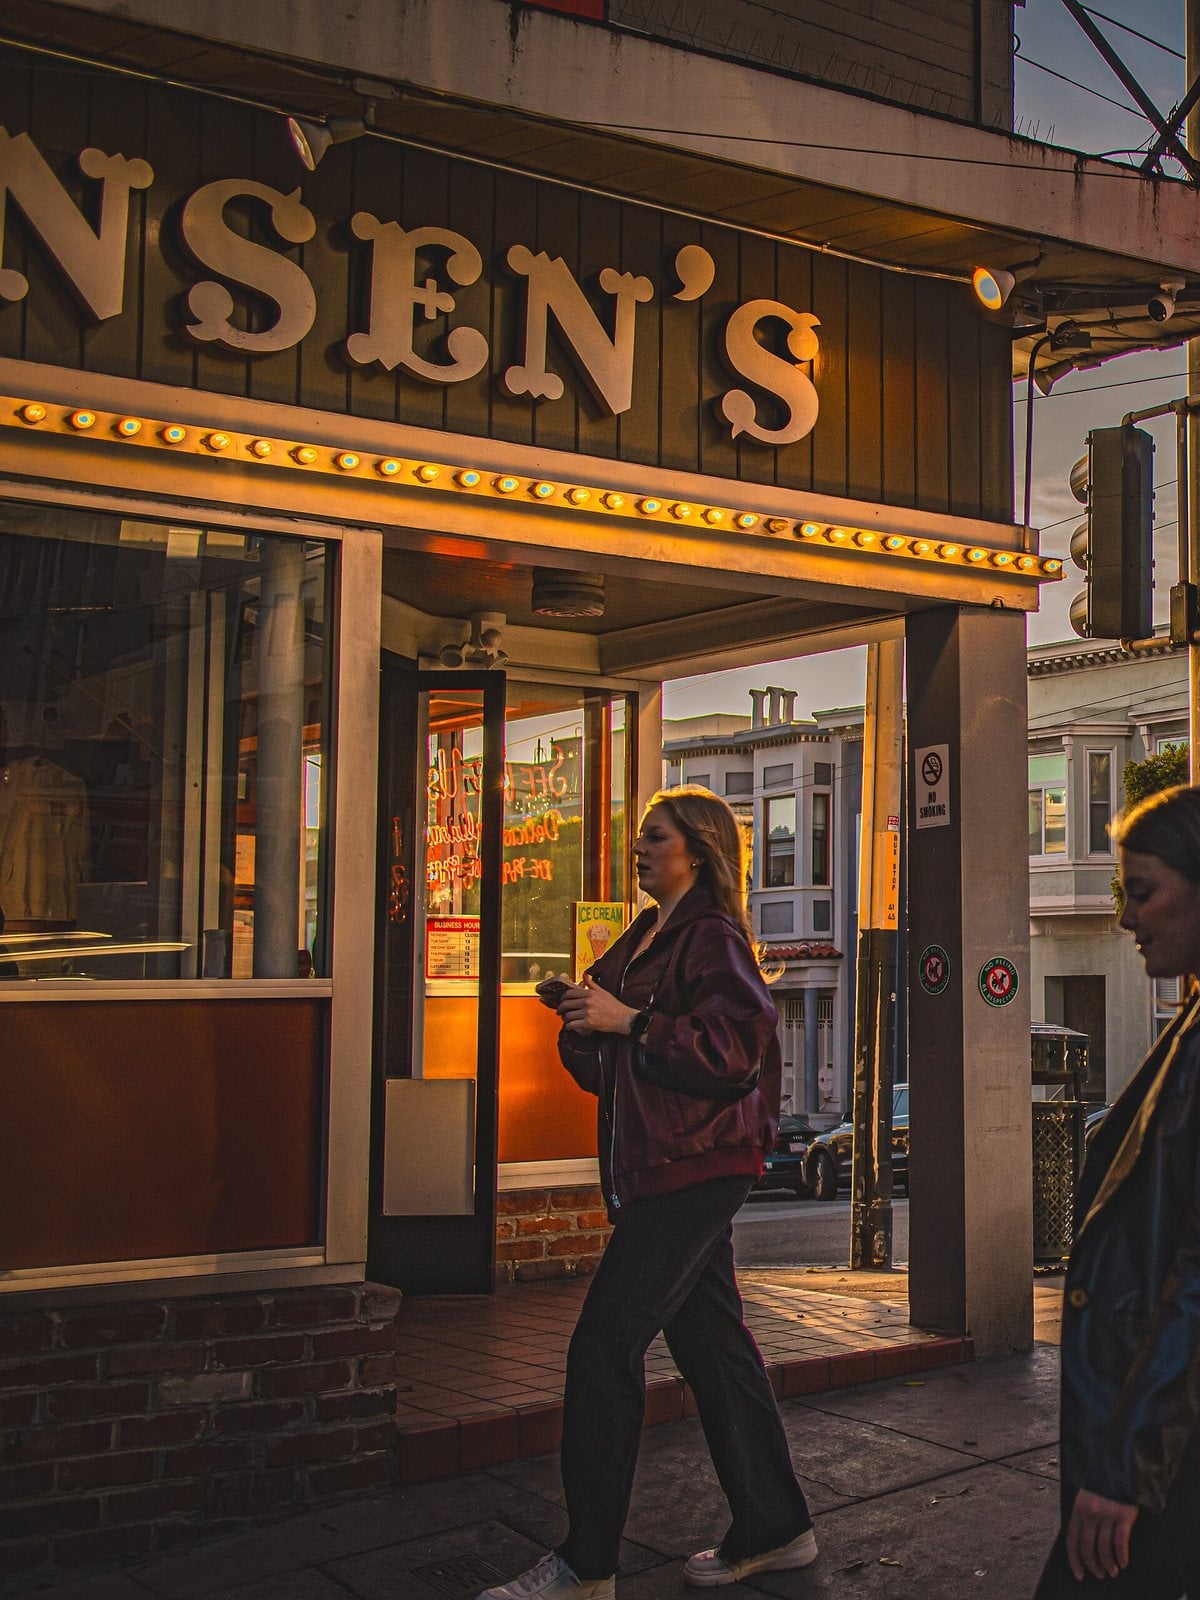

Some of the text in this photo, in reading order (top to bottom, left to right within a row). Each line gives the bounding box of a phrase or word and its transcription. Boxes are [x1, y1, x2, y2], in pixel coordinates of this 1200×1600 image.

[928, 791, 936, 803] NO
[920, 804, 946, 818] SMOKING
[578, 907, 623, 924] ICE CREAM
[434, 921, 462, 929] BUSINESS
[985, 959, 1015, 975] NO PEEING
[981, 983, 1016, 1004] BE RESPECTFUL
